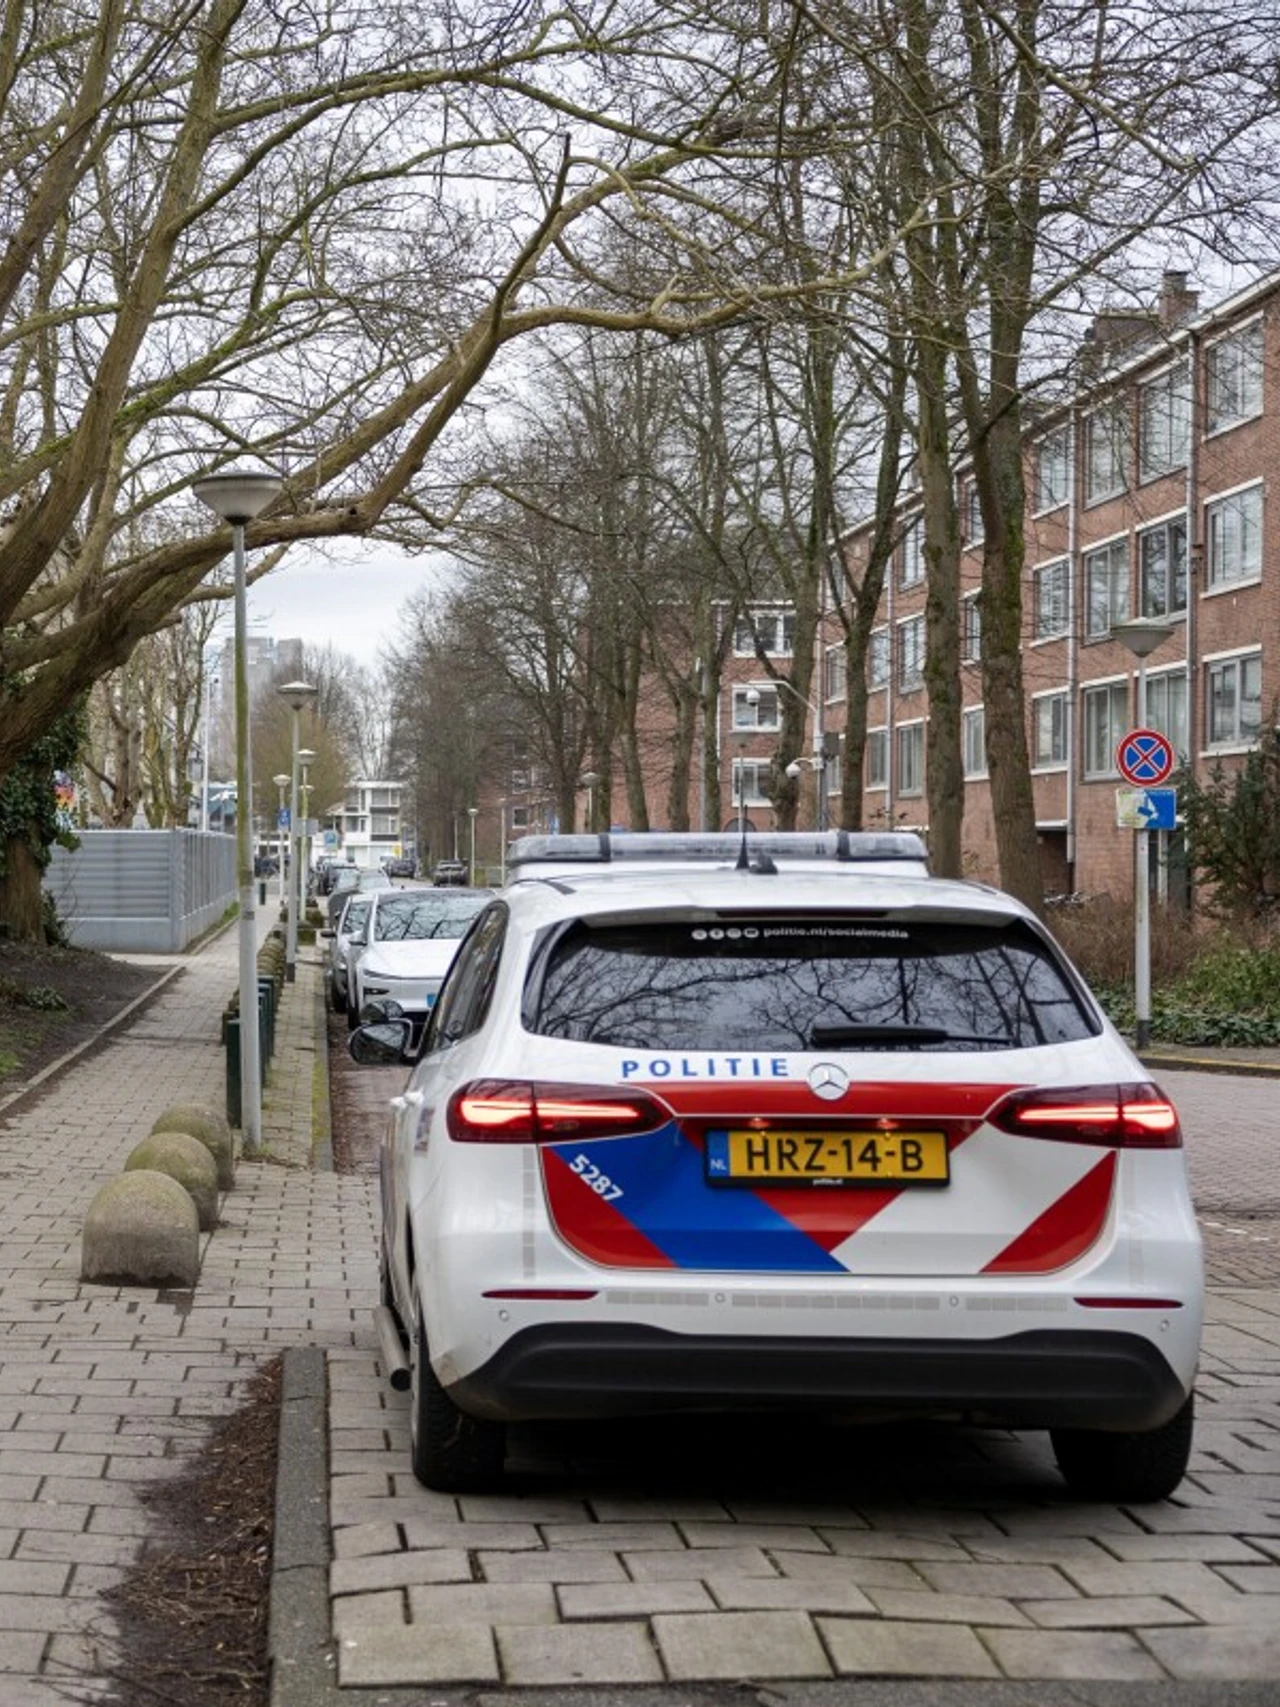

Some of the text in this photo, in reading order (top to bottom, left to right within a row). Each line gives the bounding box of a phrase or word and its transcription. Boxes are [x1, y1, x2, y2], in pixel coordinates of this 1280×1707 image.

[763, 926, 909, 939] politie.nl/socialmedia
[622, 1058, 789, 1078] POLITIE
[710, 1138, 923, 1172] NL HRZ-14-B
[569, 1154, 624, 1200] 5287
